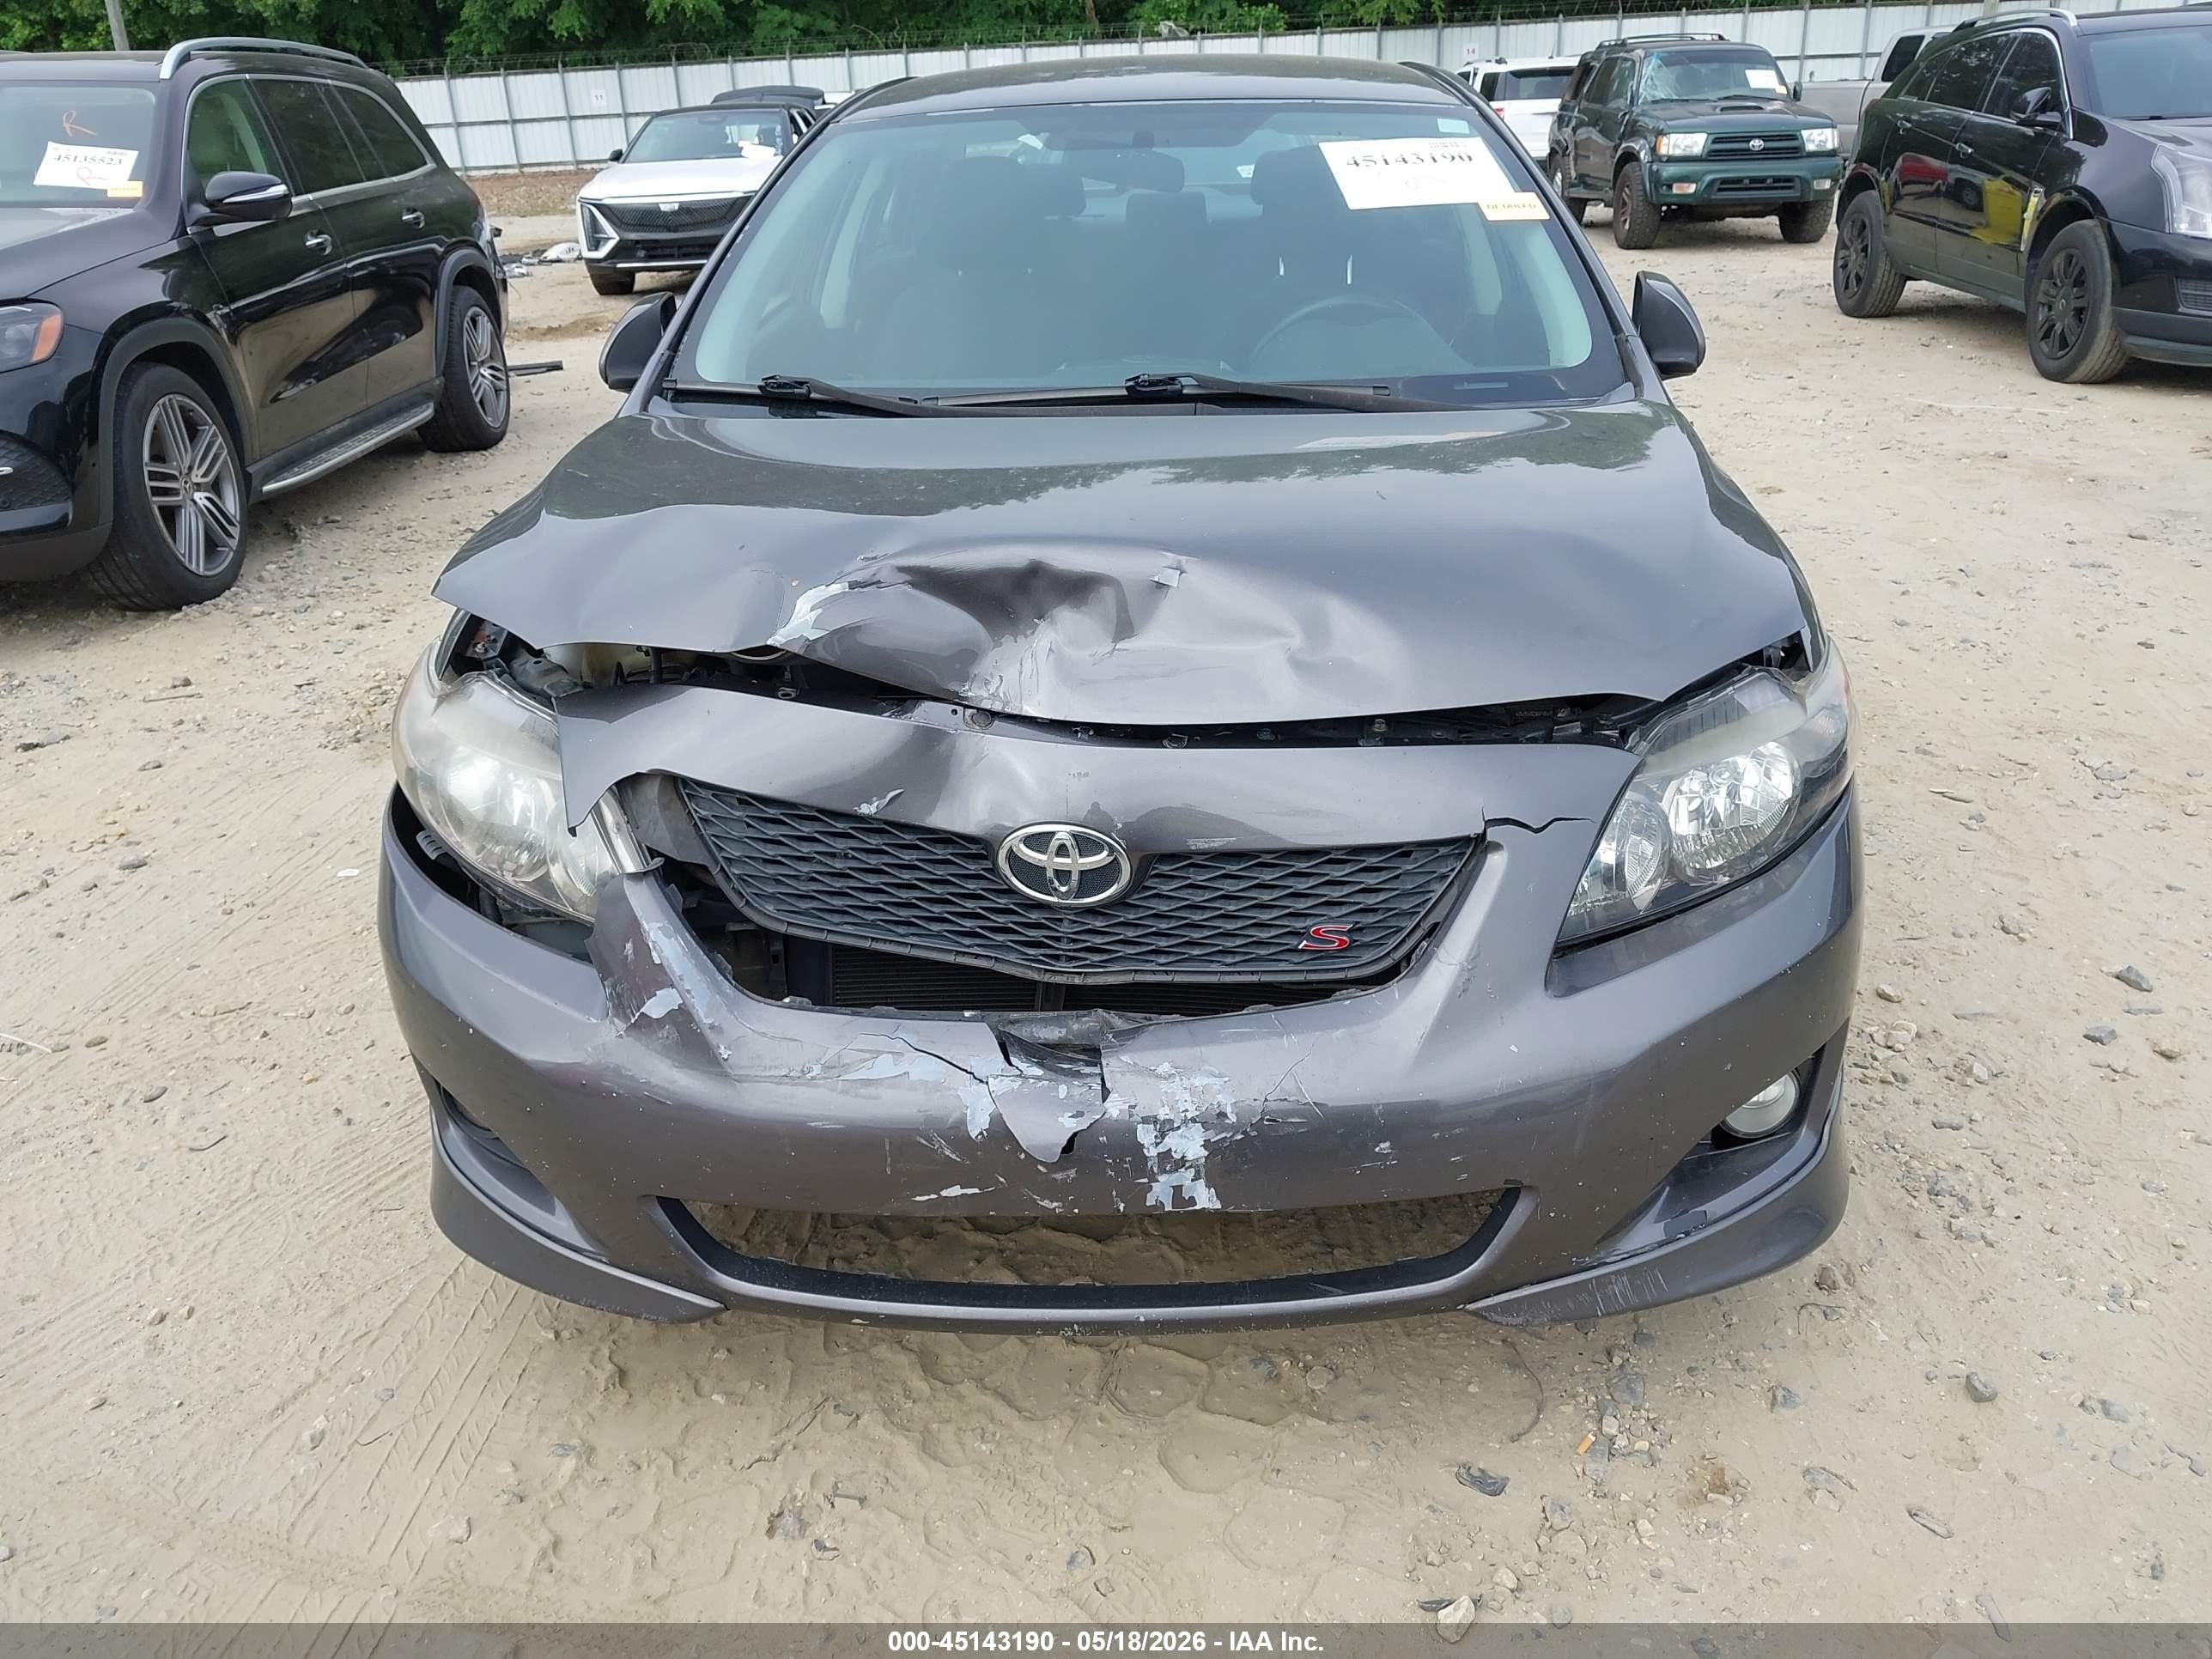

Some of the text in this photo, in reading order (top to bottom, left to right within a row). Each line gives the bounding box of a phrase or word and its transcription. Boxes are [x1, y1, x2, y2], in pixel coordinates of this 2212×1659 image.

[52, 153, 124, 166] 45135523
[1346, 150, 1474, 169] 45143190
[1297, 923, 1354, 951] S
